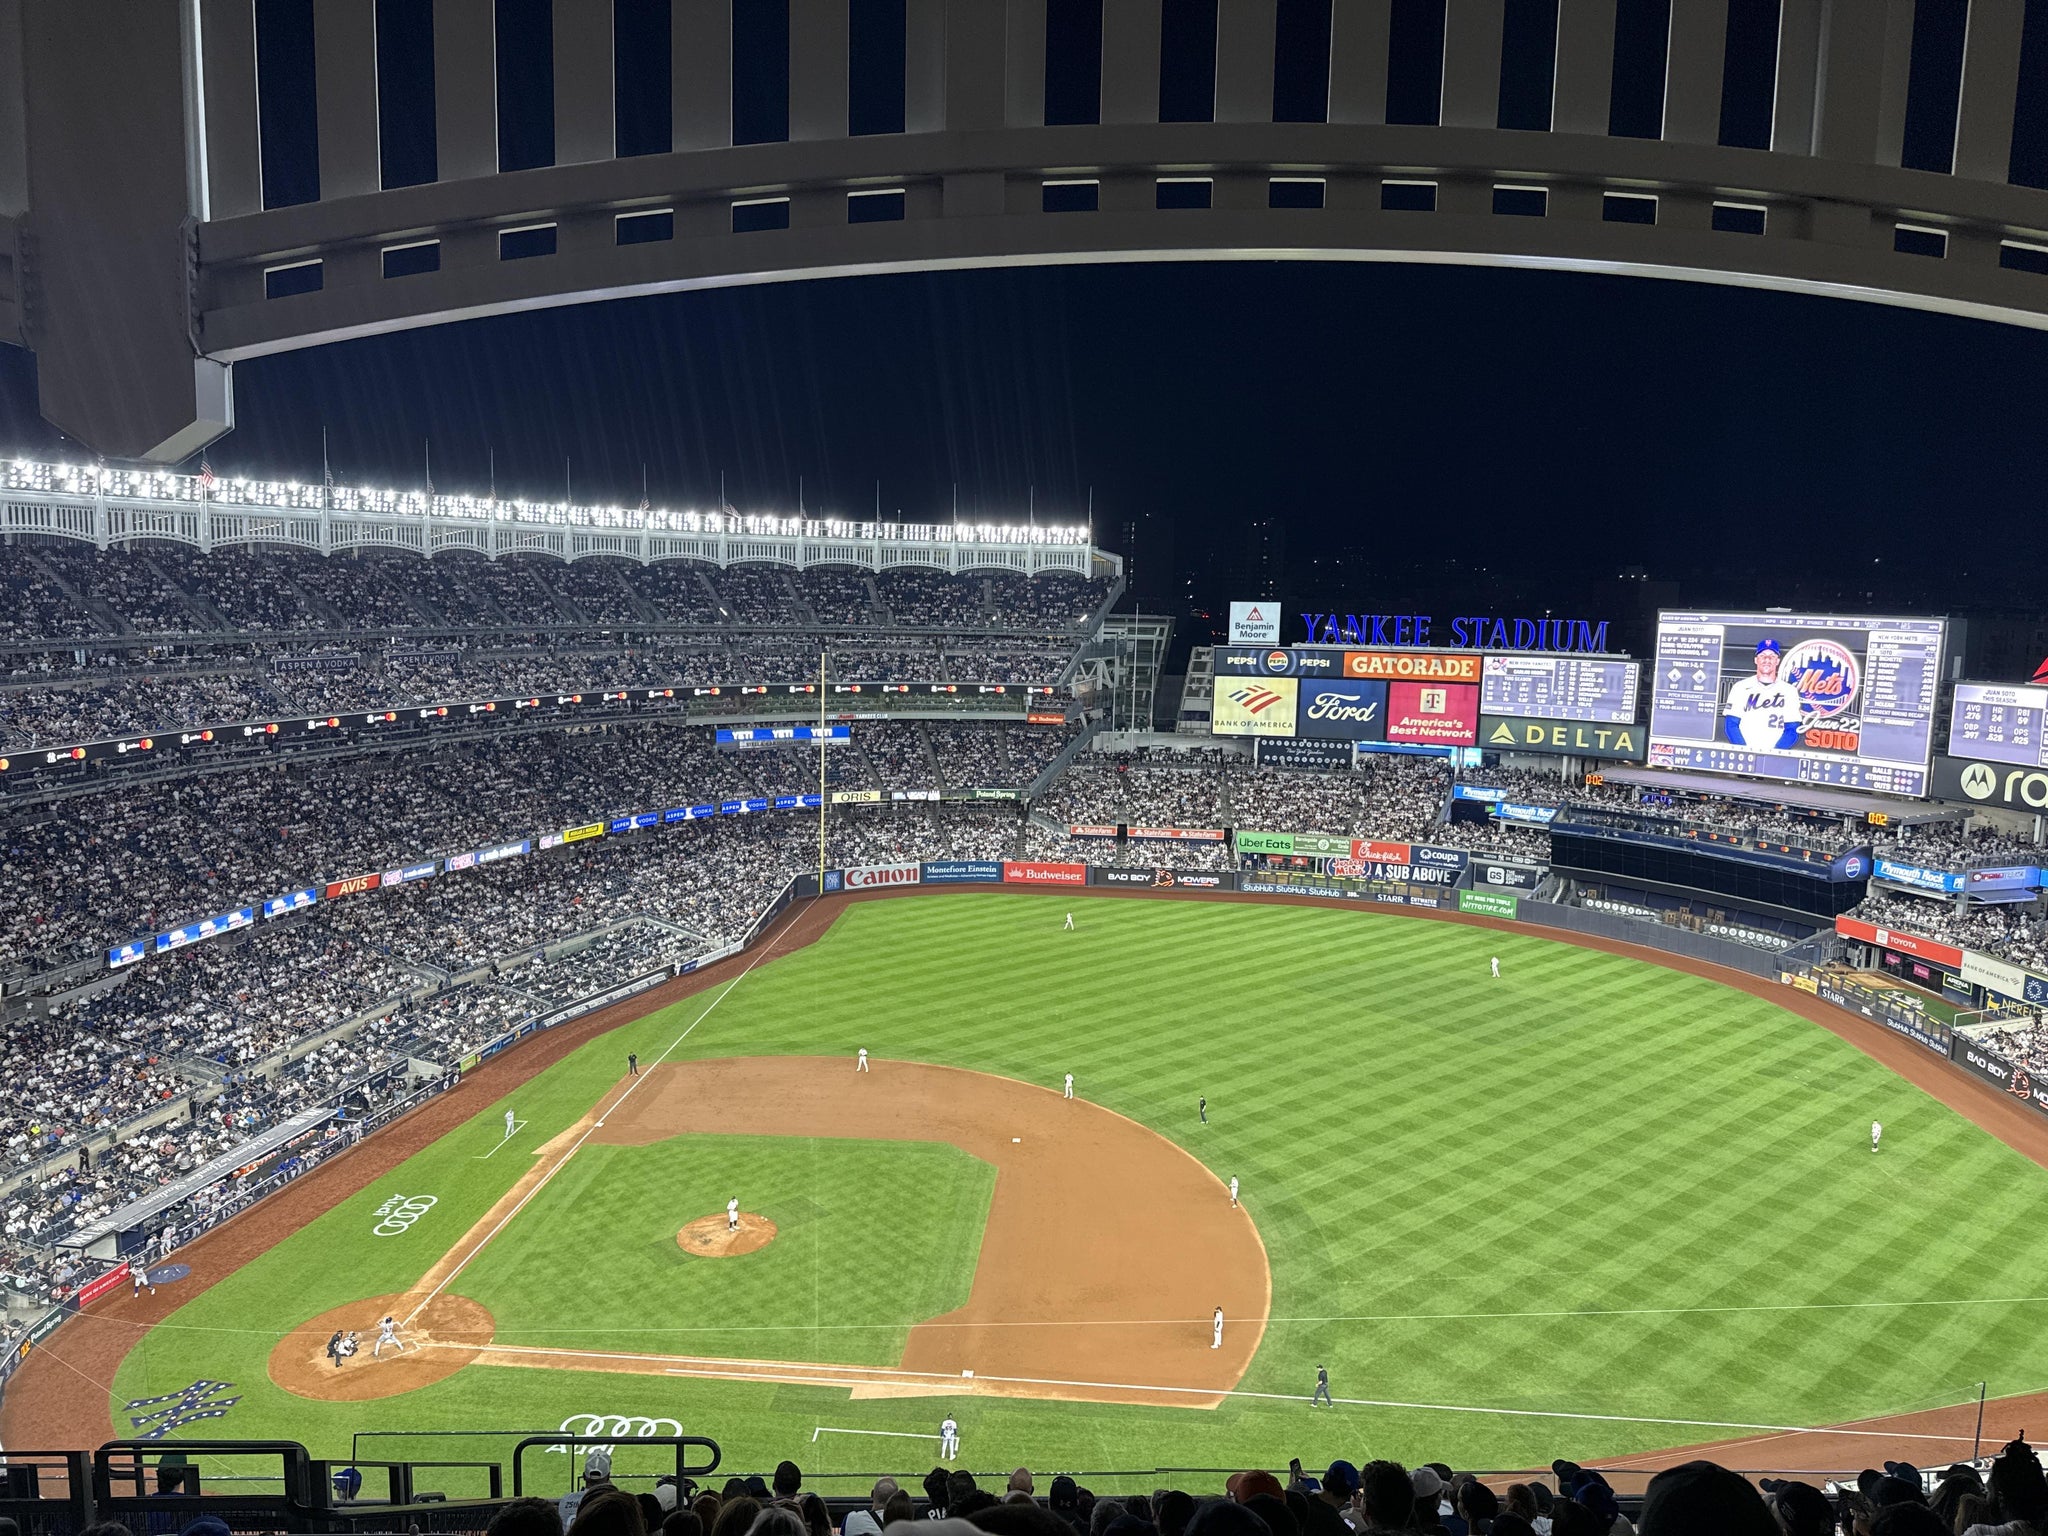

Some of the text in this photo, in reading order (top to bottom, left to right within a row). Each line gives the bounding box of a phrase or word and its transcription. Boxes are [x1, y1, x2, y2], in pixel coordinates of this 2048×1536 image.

[1235, 622, 1274, 631] Benjamin
[1301, 613, 1610, 653] YANKEE STADIUM
[281, 660, 354, 670] ASPEN VODKA
[1227, 657, 1257, 665] PEPSI
[1300, 659, 1330, 667] PEPSI
[1352, 656, 1474, 677] GATORADE
[1799, 668, 1844, 695] Mets
[1307, 692, 1378, 722] Ford
[1744, 692, 1785, 712] Mets
[1400, 717, 1463, 728] America's
[1796, 710, 1860, 734] Juan 22
[732, 731, 754, 740] YETI
[772, 729, 794, 738] YETI
[1390, 725, 1474, 738] Best Network
[2014, 728, 2029, 736] OPS
[1526, 725, 1634, 752] DELTA
[1805, 729, 1858, 751] SOTO
[2012, 736, 2029, 745] .925
[1841, 765, 1847, 773] 3
[1852, 766, 1858, 774] 2
[1872, 767, 1892, 775] BALLS
[1585, 775, 1604, 785] 0:02
[1811, 771, 1819, 780] 10
[1840, 775, 1846, 783] 4
[1851, 776, 1857, 784] 2
[1873, 782, 1891, 790] OUTS
[841, 792, 871, 802] ORIS
[976, 790, 1016, 799] Poland Spring
[1502, 804, 1536, 815] Plymouth
[613, 821, 629, 829] ASPEN
[1868, 812, 1888, 826] 0:02
[1240, 838, 1264, 847] Uber
[1266, 840, 1291, 849] Eats
[1432, 851, 1459, 862] coupa
[846, 867, 918, 886] Canon
[926, 866, 966, 874] Montefiore
[1375, 864, 1451, 883] A SUB ABOVE
[1490, 871, 1502, 880] GS
[1881, 862, 1945, 884] Plymouth Rock
[338, 877, 368, 895] AVIS
[1177, 876, 1219, 884] MOWERS
[1244, 884, 1339, 897] StubHub StubHub StubHub
[1377, 894, 1403, 903] STARR
[1462, 901, 1514, 916] NITTOTIRE.COM
[1889, 936, 1917, 949] TOYOTA
[1964, 963, 1977, 972] BANK
[1986, 971, 2009, 982] AMERICA
[1947, 977, 1969, 989] ARENA
[1822, 988, 1845, 1005] STARR
[1887, 1018, 1948, 1055] StubHub StubHub StubHub
[1967, 1051, 1986, 1069] BAD
[1987, 1062, 2008, 1080] BOY
[372, 1194, 406, 1216] Audi
